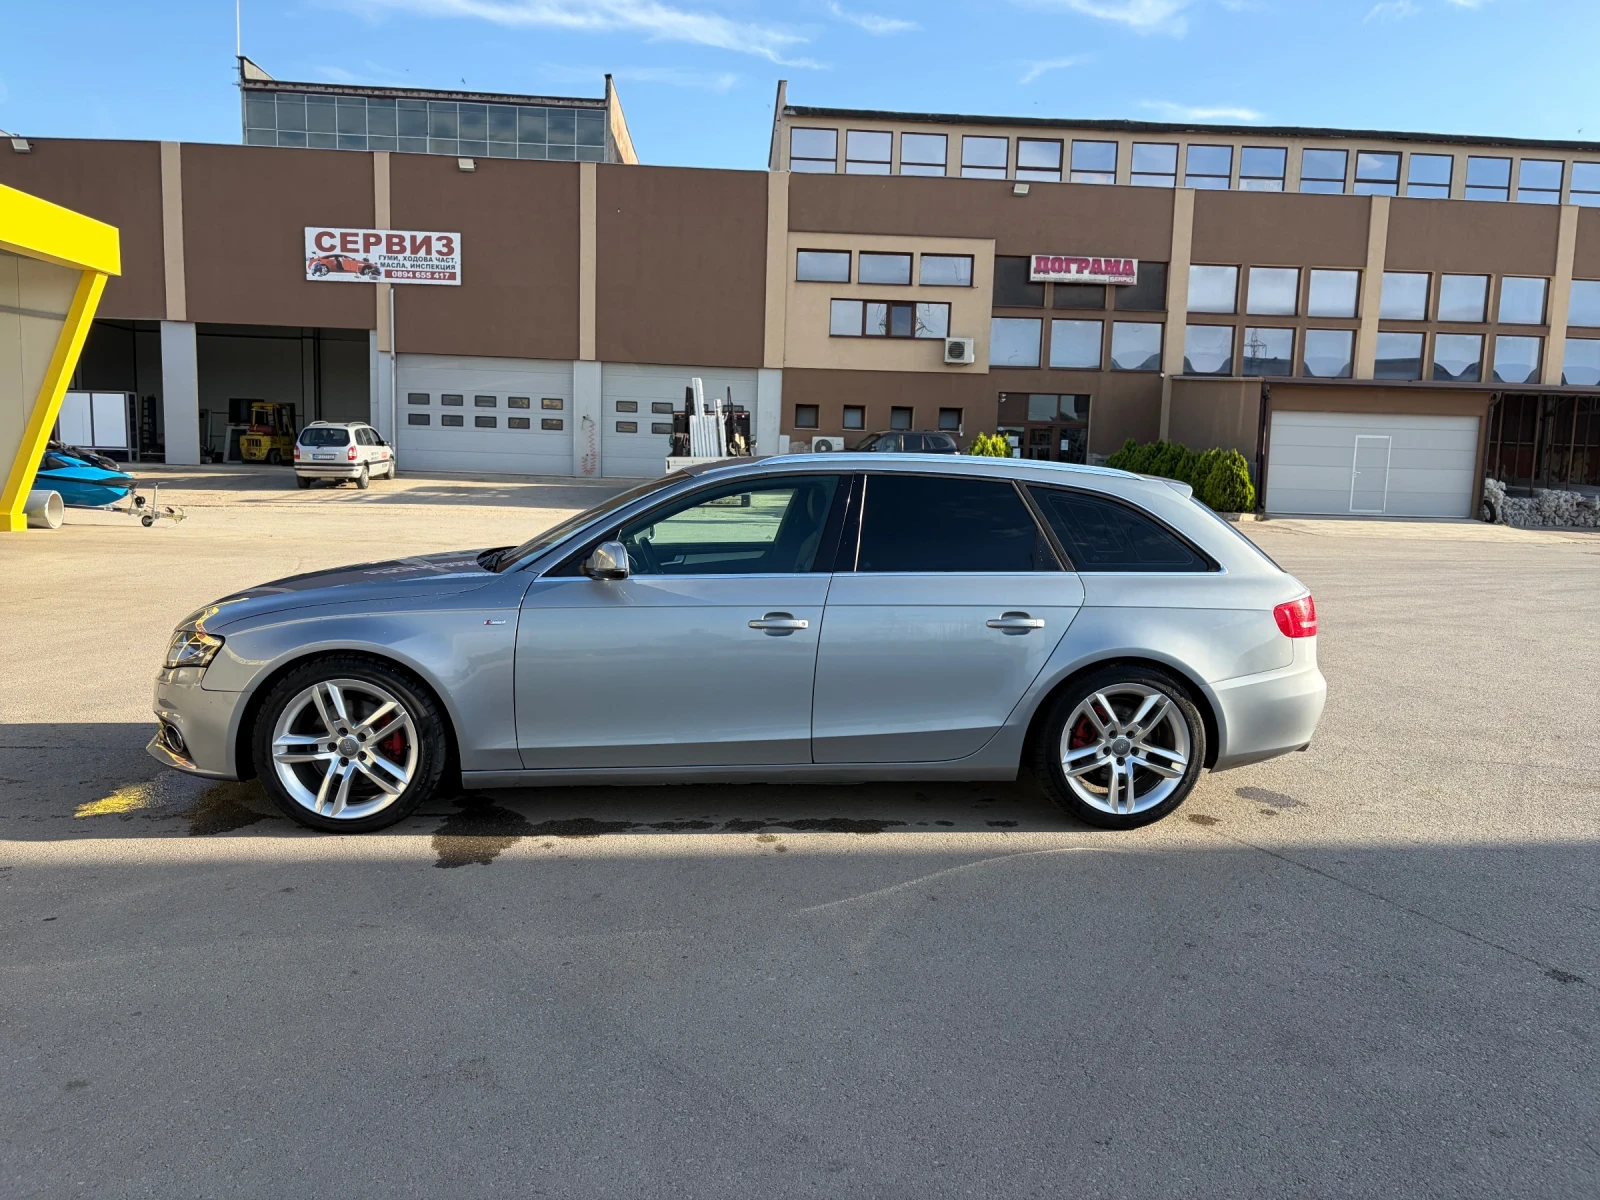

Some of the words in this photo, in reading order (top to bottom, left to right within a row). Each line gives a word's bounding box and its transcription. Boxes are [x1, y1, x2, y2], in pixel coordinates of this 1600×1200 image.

[314, 231, 455, 257] СЕРВИЗ
[378, 254, 401, 263] ГУМИ,
[402, 255, 434, 263] ХОДОВА
[435, 256, 457, 265] ЧАСТ,
[410, 263, 456, 271] ИНСПЕКЦИЯ
[1033, 256, 1136, 276] ДОГРАМА
[391, 270, 414, 278] 0894
[433, 272, 450, 280] 417
